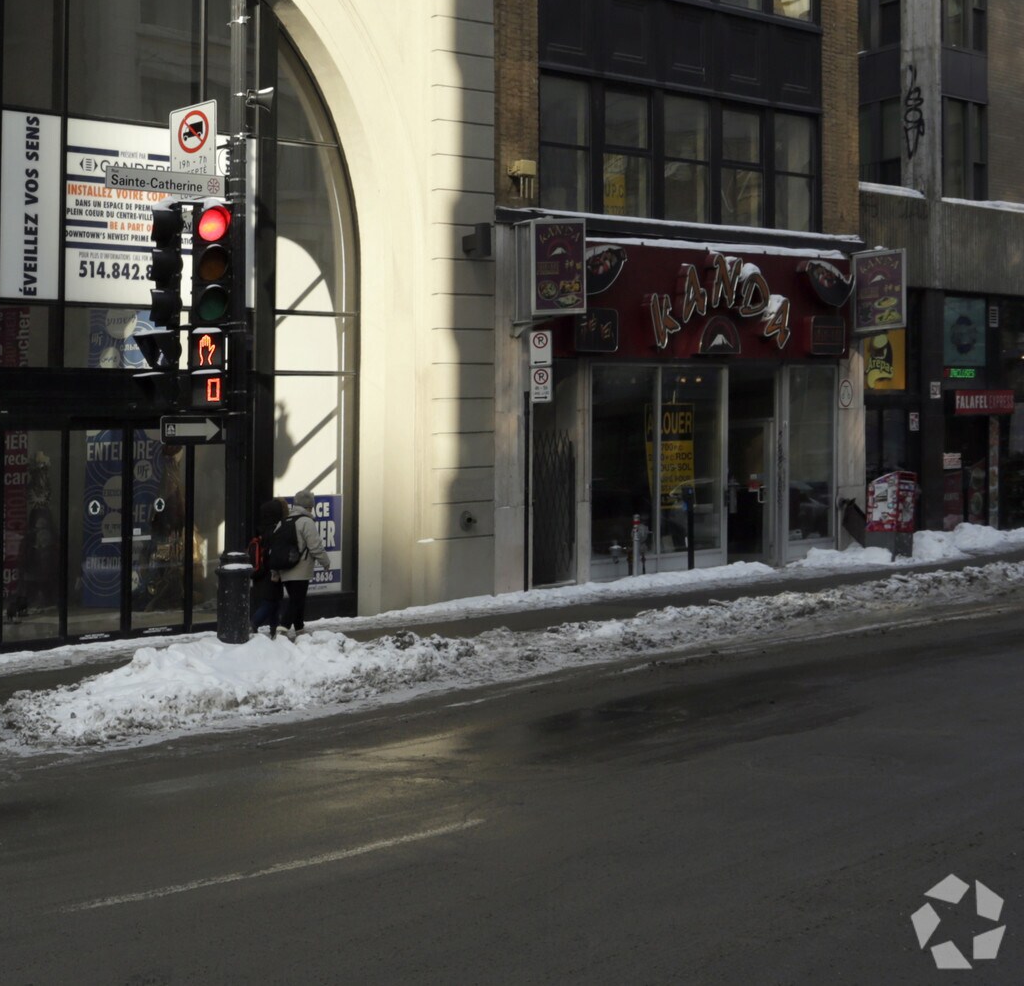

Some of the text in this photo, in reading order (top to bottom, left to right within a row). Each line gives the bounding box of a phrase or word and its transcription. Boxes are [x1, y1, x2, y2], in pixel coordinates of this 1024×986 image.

[68, 183, 113, 199] INSTALLEZ
[111, 174, 203, 193] Sainte-Catherine
[19, 115, 40, 296] ÉVEILLEZ VOS SENS
[75, 199, 91, 207] DANS
[93, 200, 102, 208] UN
[103, 201, 123, 210] ESPACE
[66, 207, 153, 221] PLEIN COEUR DU CENTRE-VILLE
[110, 221, 118, 230] BE
[121, 222, 126, 231] A
[128, 222, 144, 232] PART
[65, 229, 149, 242] DOWNTOWN'S NEWEST PRIME
[650, 254, 791, 349] KANDA
[865, 357, 894, 374] Arepas
[955, 394, 1014, 409] FALAFEL EXPRESS
[661, 411, 692, 435] OUER
